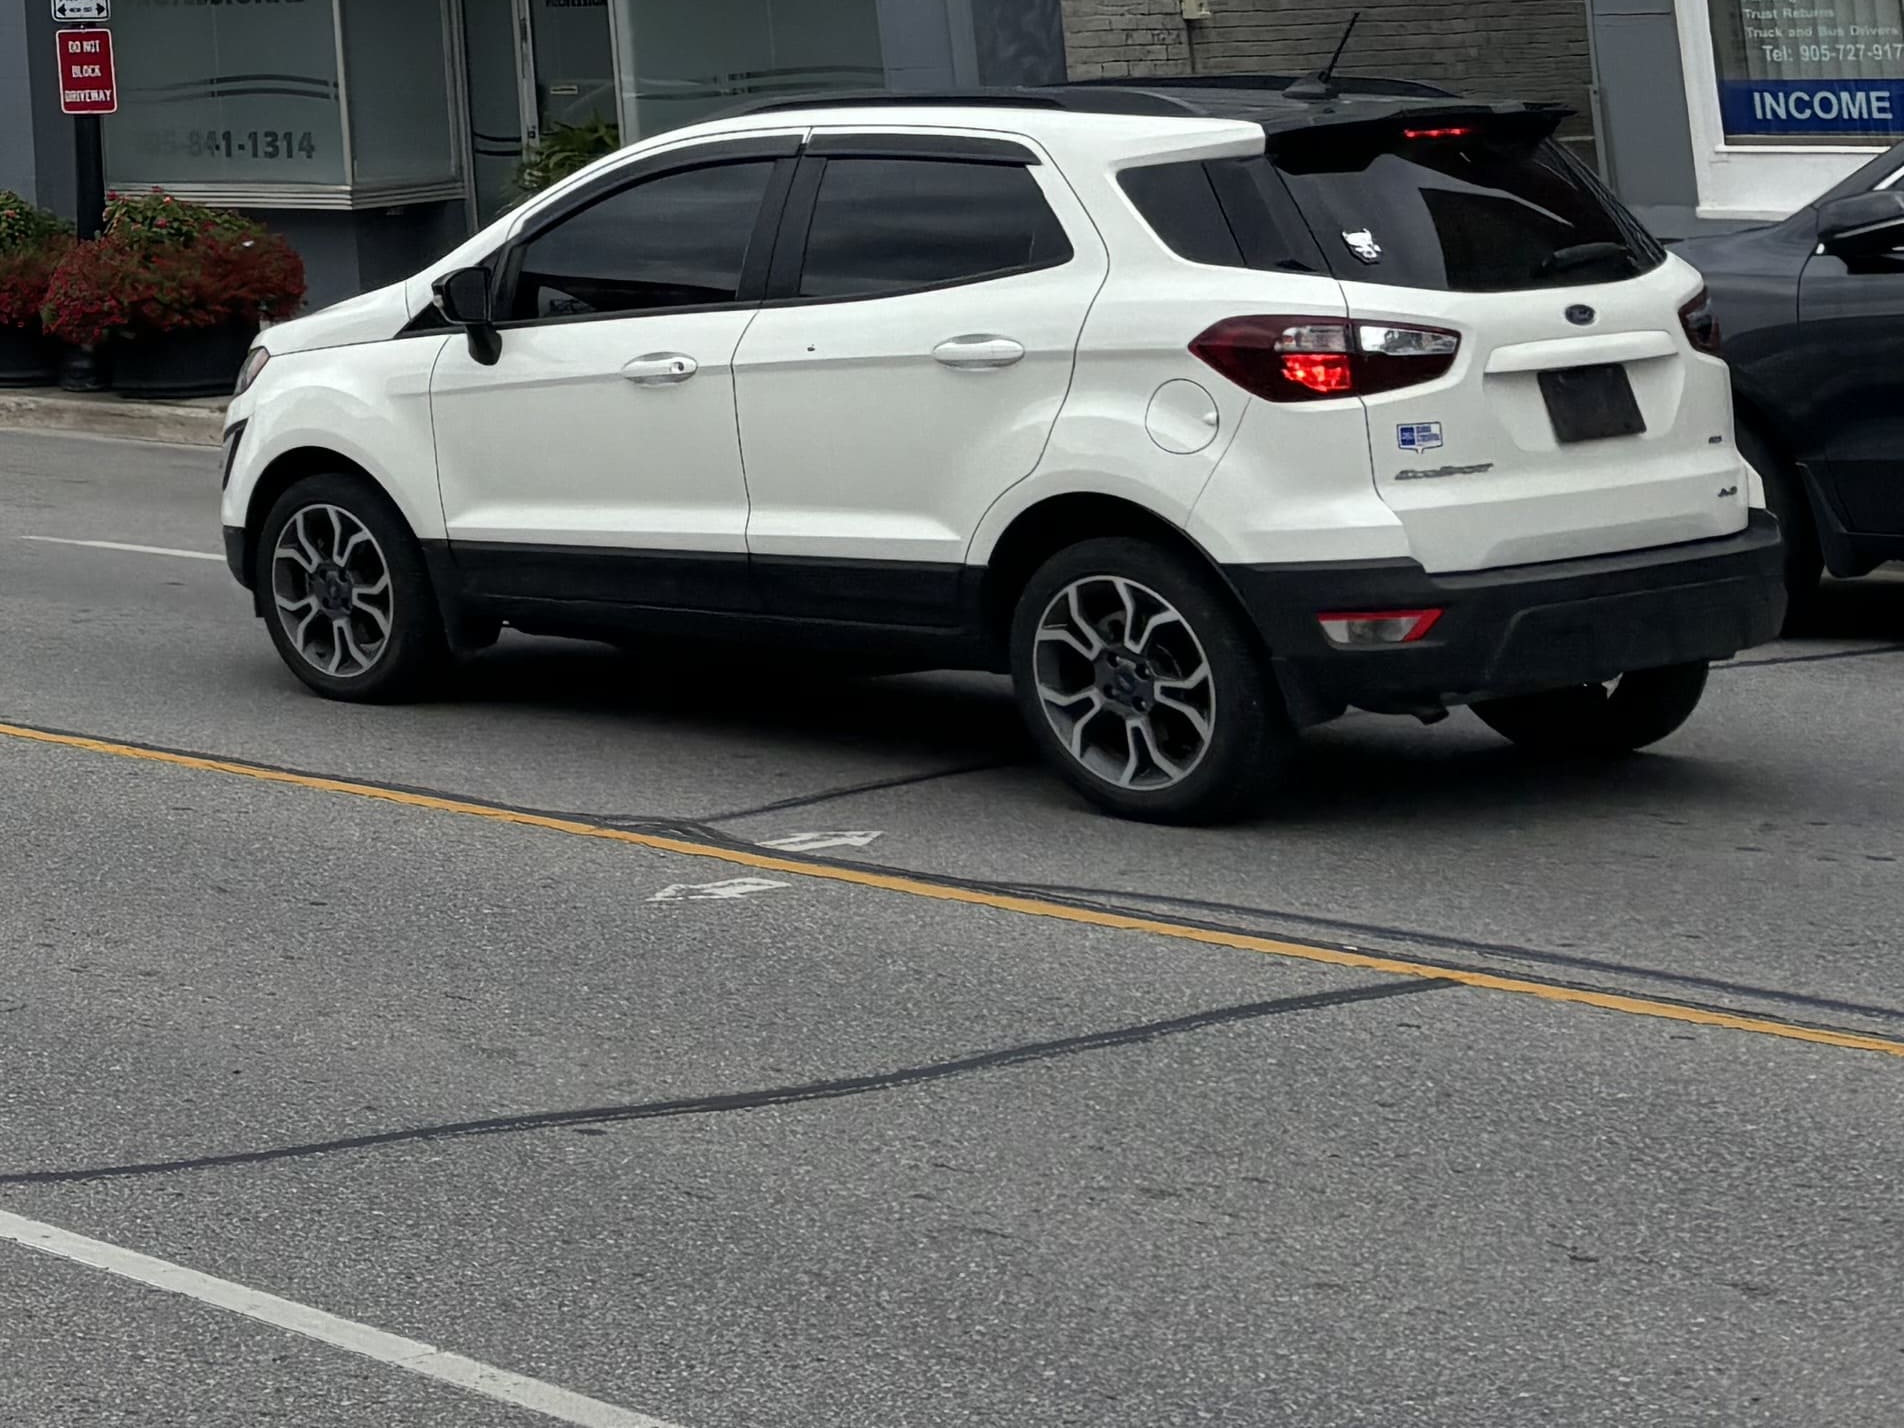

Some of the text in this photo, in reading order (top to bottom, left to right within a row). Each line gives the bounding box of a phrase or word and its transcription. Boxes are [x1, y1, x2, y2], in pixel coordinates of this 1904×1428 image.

[1744, 7, 1834, 20] Trust Returns
[1746, 24, 1900, 38] Truck and Bus Drivers
[68, 39, 100, 53] DO NOT
[1762, 43, 1904, 62] Tel: 905-727-917
[71, 64, 102, 78] BLOCK
[64, 89, 113, 103] DRIVEWAY
[1752, 91, 1893, 120] INCOME
